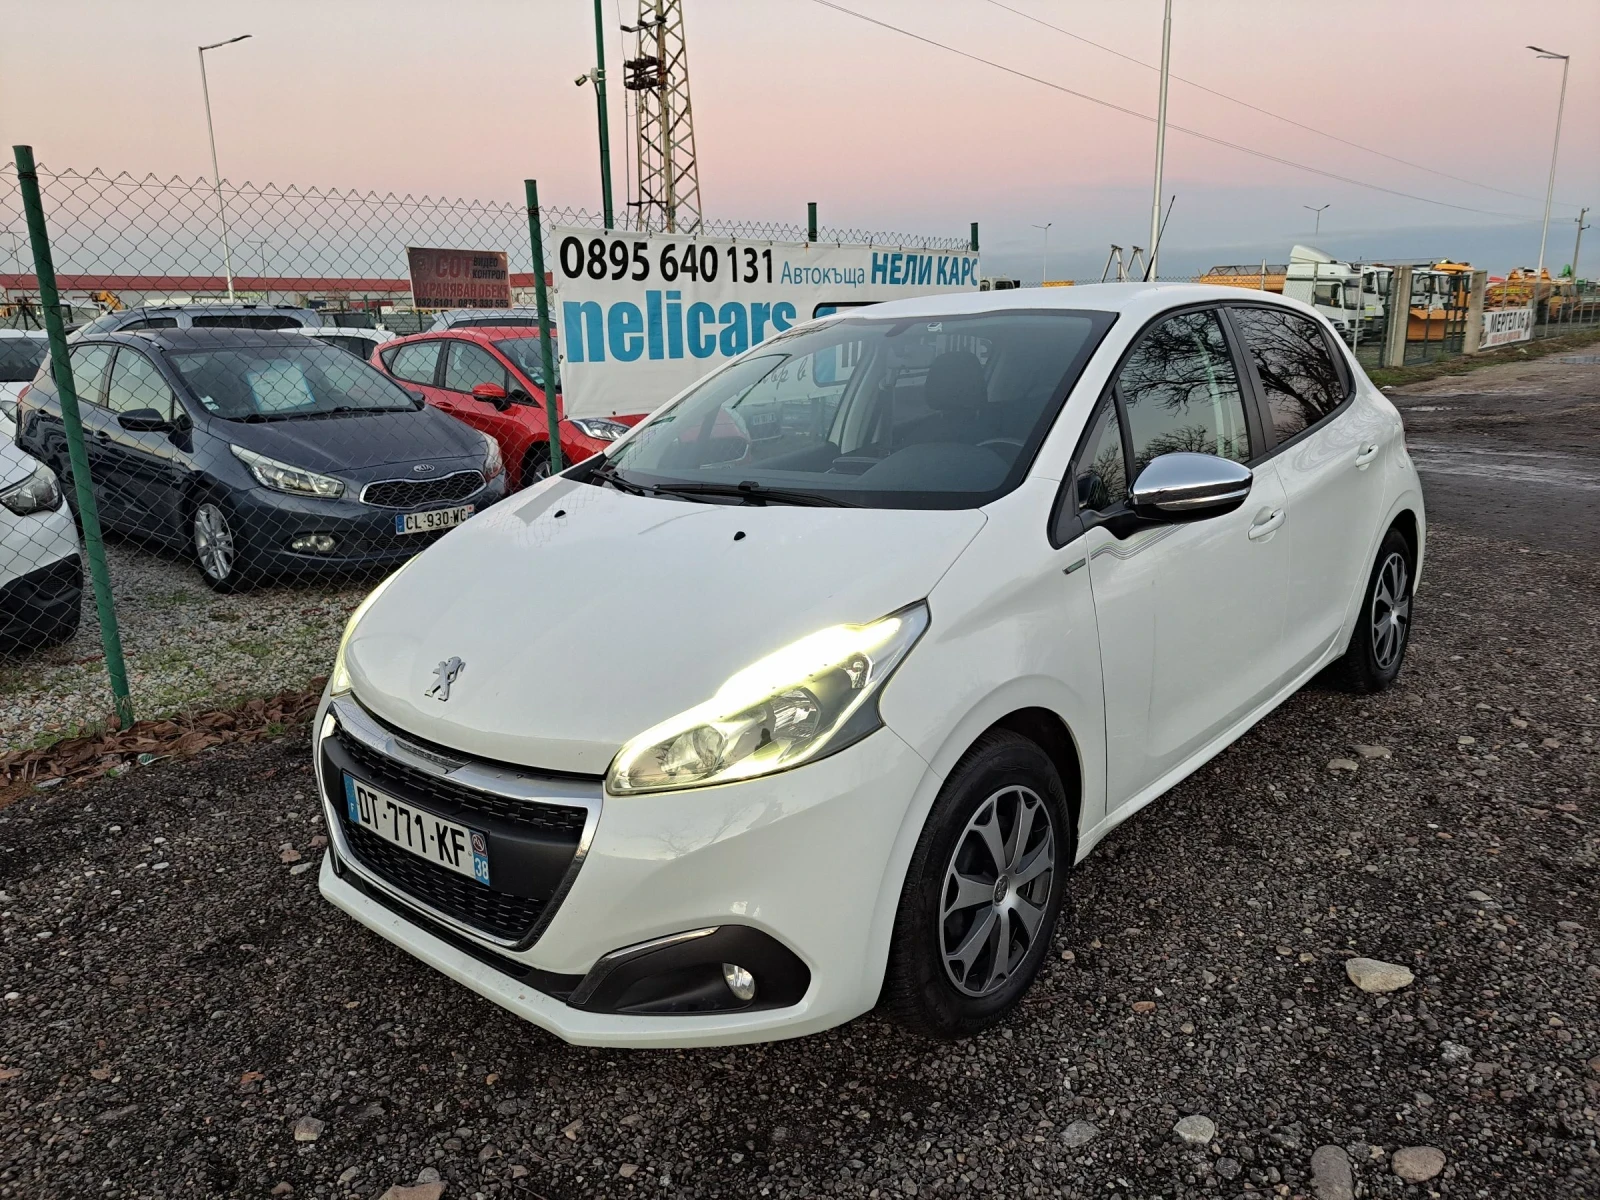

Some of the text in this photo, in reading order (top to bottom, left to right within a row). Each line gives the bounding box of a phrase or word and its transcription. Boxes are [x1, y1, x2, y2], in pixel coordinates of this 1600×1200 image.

[436, 255, 473, 279] СОТ
[473, 257, 498, 269] ВИДЕО
[560, 236, 773, 283] 0895 640 131
[781, 252, 978, 288] Автокъща НЕЛИ КАРС
[472, 269, 506, 280] КОНТРОЛ
[415, 281, 510, 299] ОХРАНЯВАН ОБЕКТ
[416, 298, 432, 308] 032
[563, 290, 799, 363] nelicars
[357, 786, 465, 867] DT-771-KF
[474, 858, 489, 880] 38
